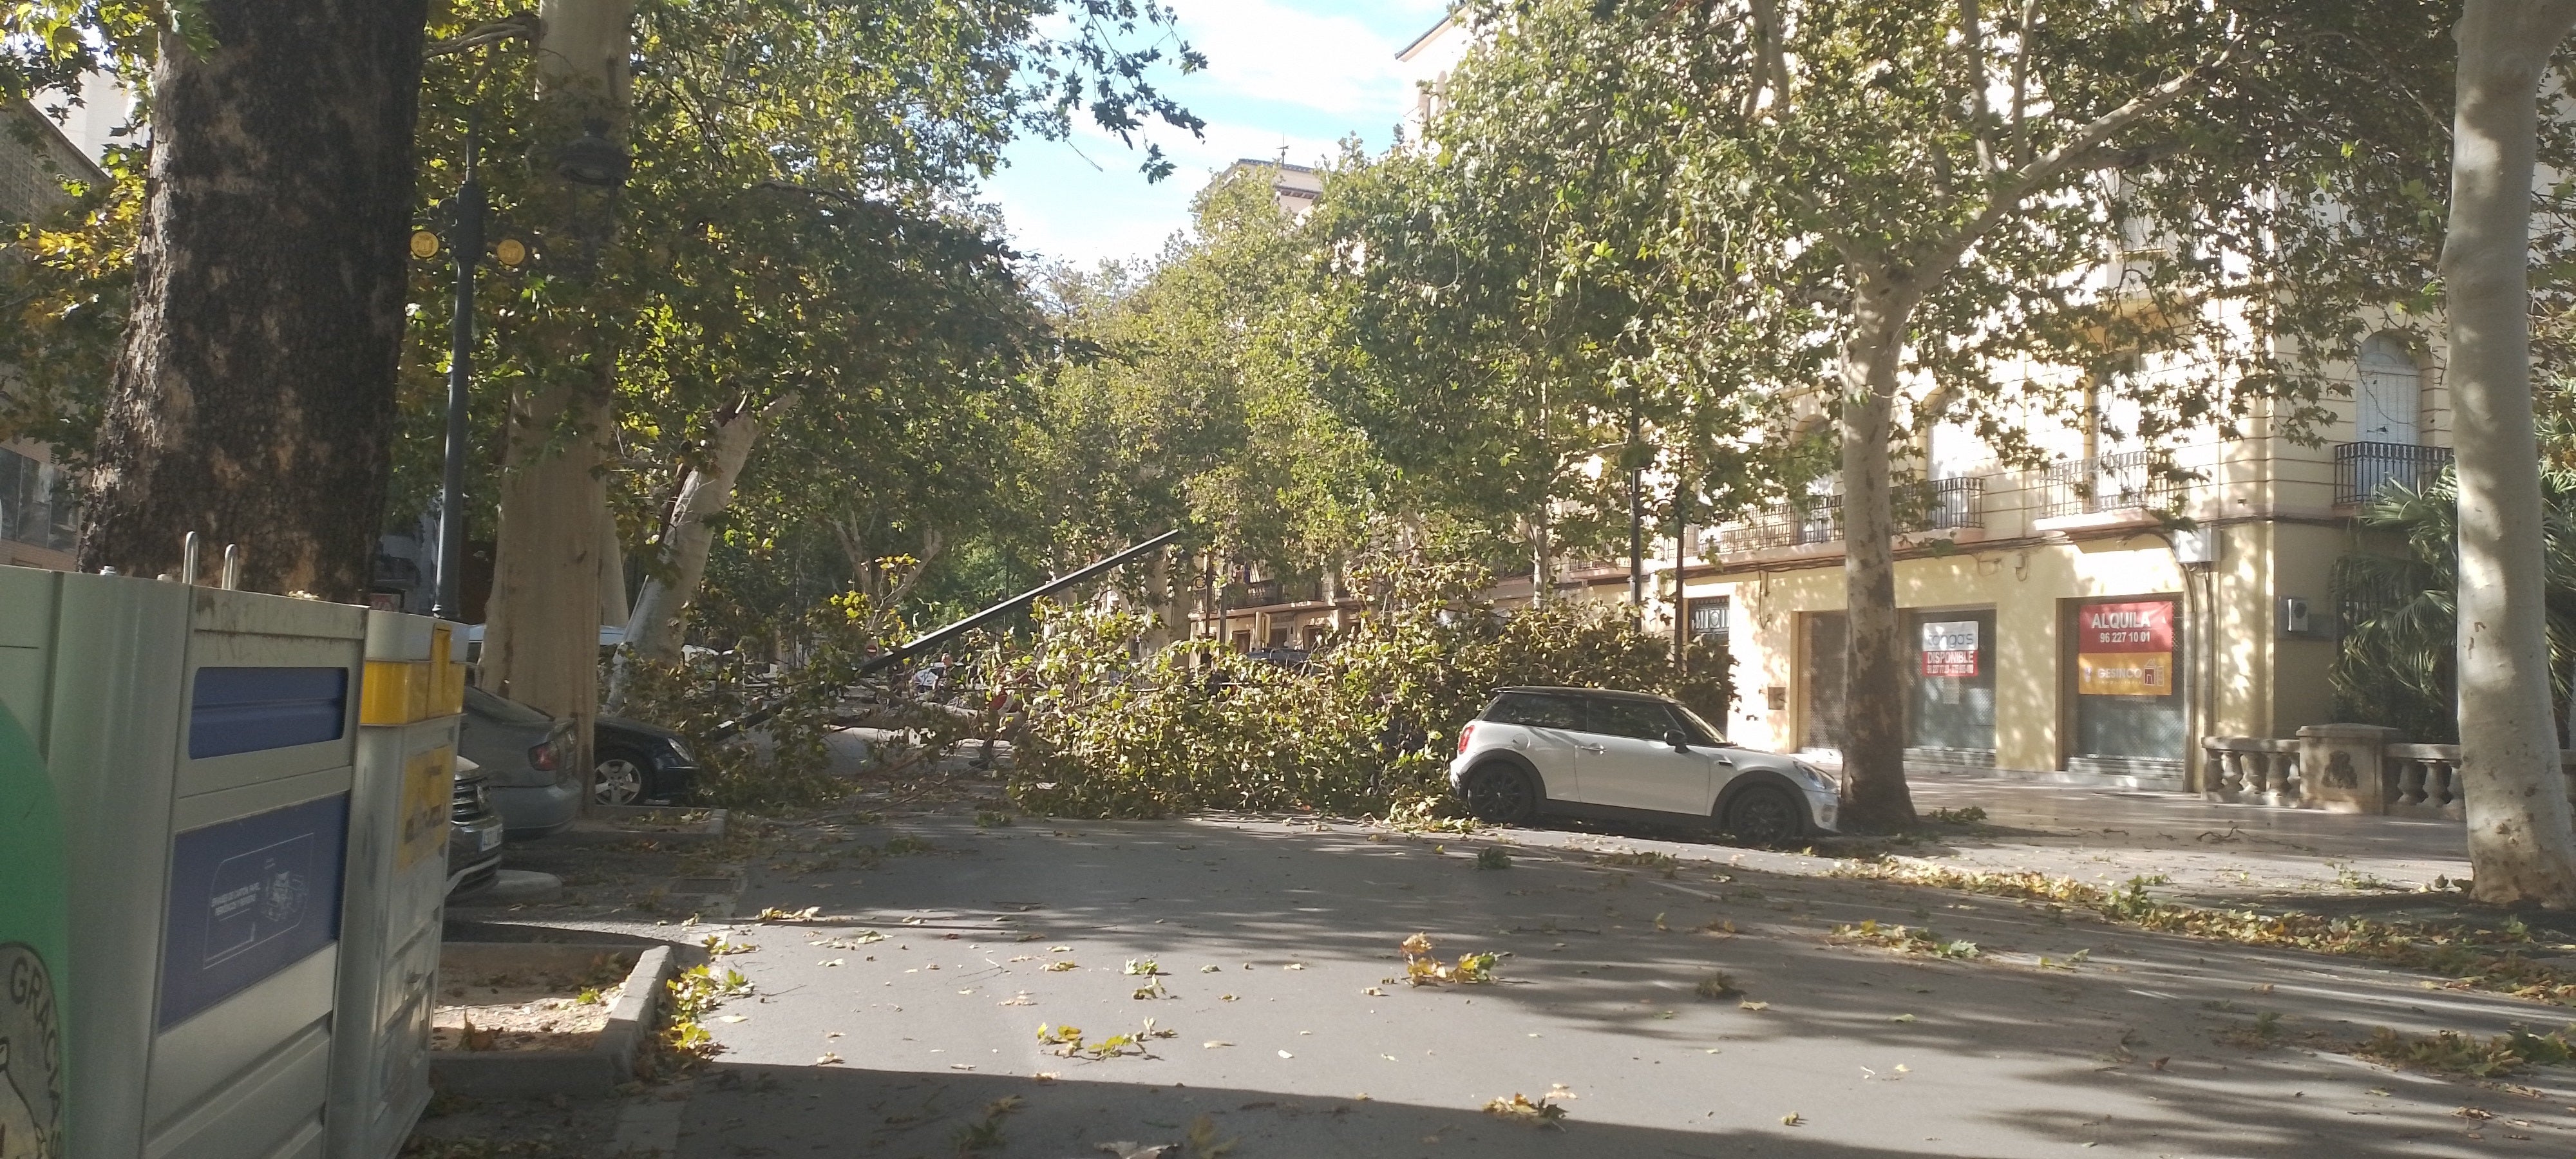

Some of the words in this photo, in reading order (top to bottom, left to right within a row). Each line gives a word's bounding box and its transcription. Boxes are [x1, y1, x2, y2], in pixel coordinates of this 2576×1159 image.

[2091, 611, 2151, 628] ALQUILA
[2100, 632, 2110, 643] 96
[2112, 632, 2126, 643] 227
[2129, 631, 2138, 642] 10
[2141, 631, 2150, 642] 01
[1927, 650, 1974, 664] DISPONIBLE
[2098, 668, 2143, 679] GESINCO
